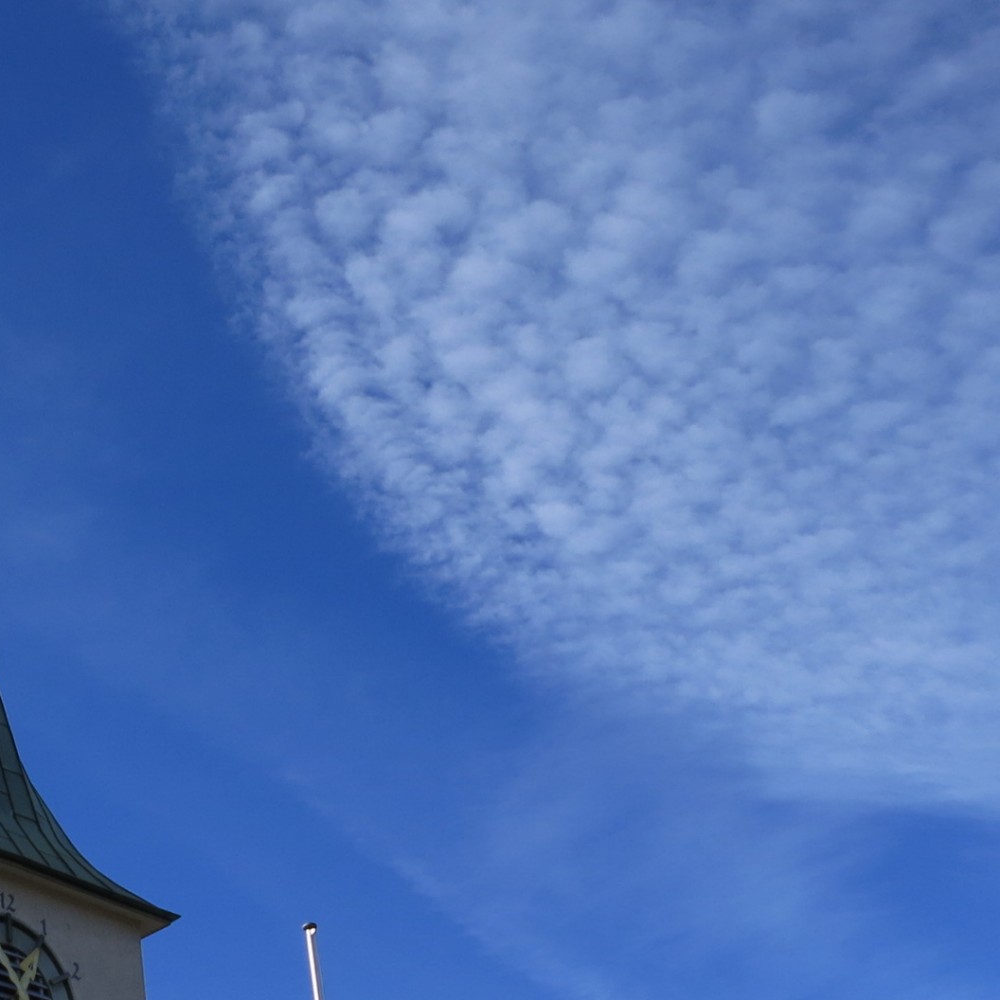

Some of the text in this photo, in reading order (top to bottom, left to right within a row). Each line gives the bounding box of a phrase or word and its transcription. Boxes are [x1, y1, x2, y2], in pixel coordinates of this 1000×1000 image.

[0, 893, 16, 912] 12
[40, 919, 48, 935] 1
[70, 963, 81, 980] 2
